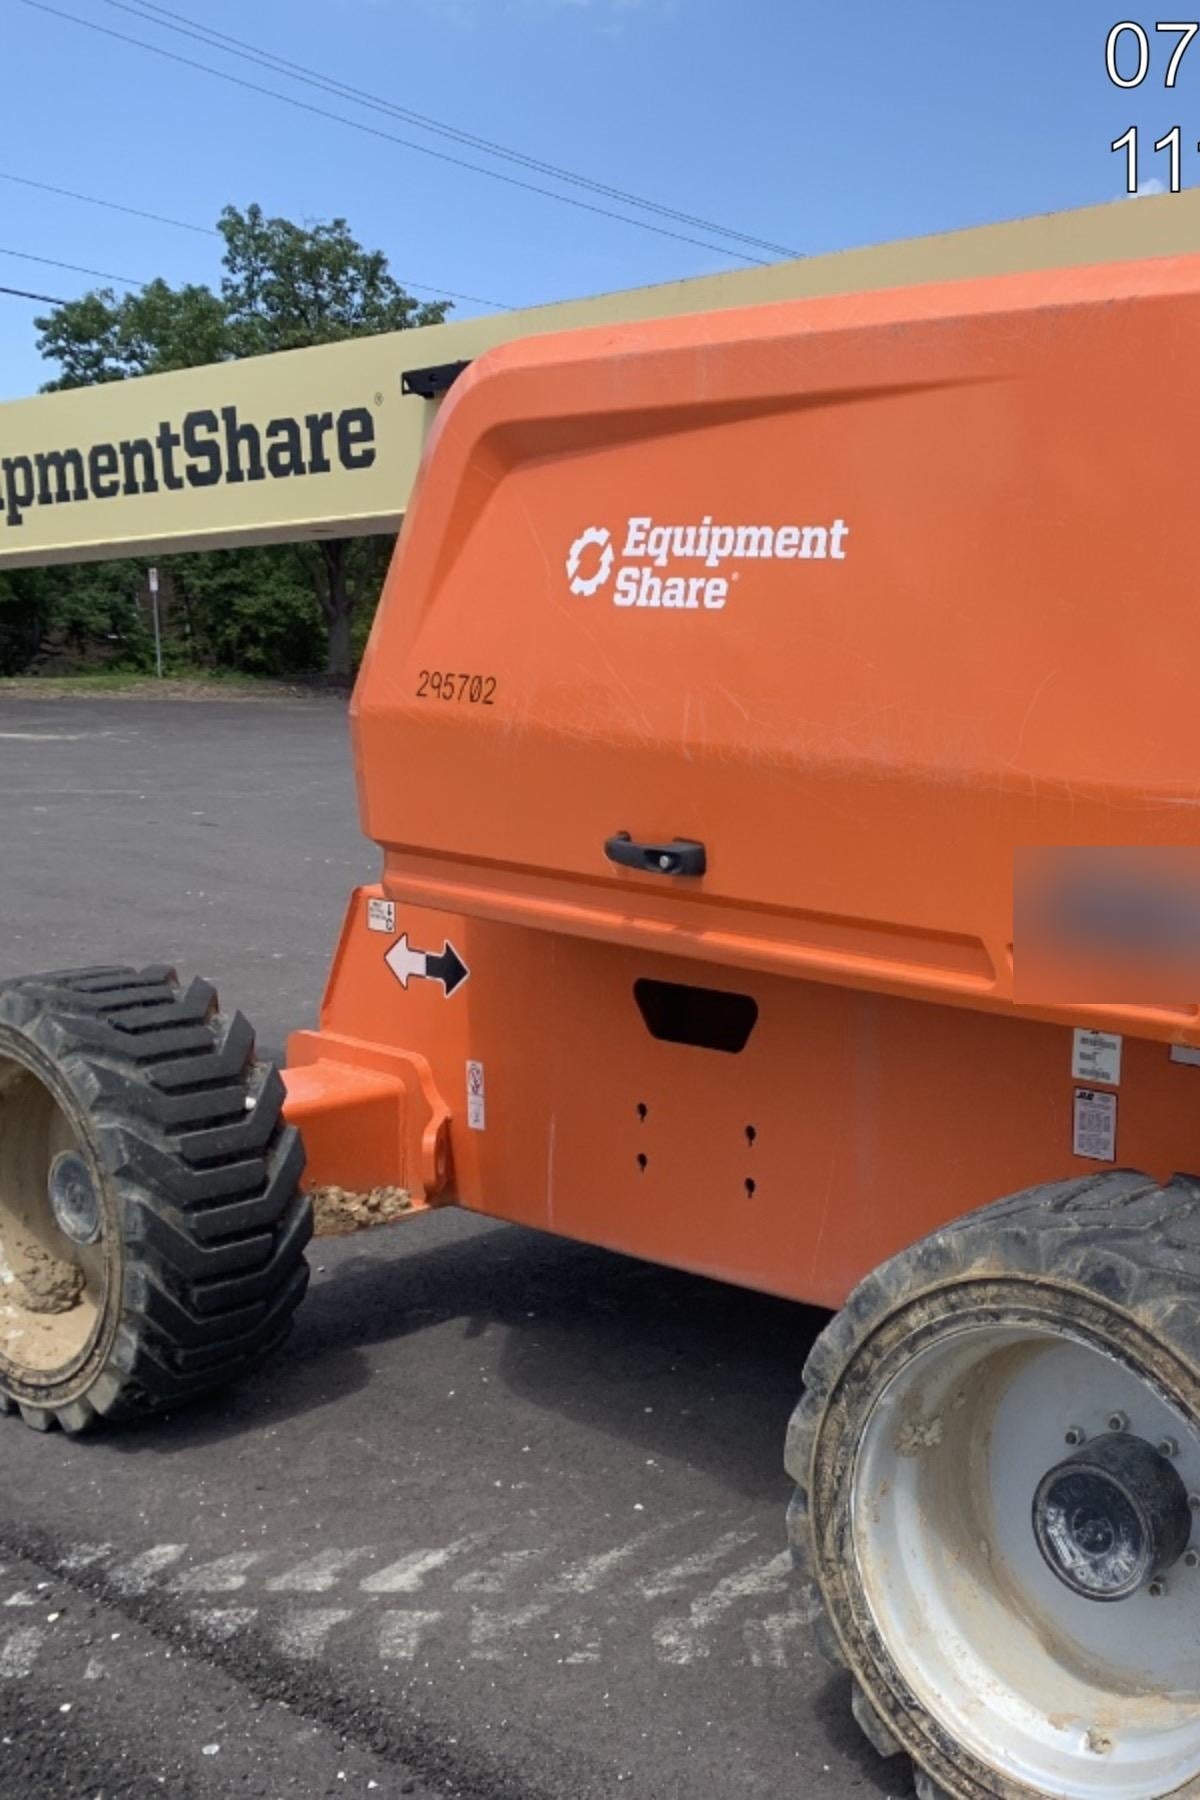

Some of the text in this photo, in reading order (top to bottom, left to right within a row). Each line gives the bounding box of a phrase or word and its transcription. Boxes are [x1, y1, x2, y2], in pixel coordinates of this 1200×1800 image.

[0, 405, 376, 526] pmentShare
[621, 515, 849, 567] Equipment
[613, 566, 728, 609] Share
[416, 669, 497, 705] 295702
